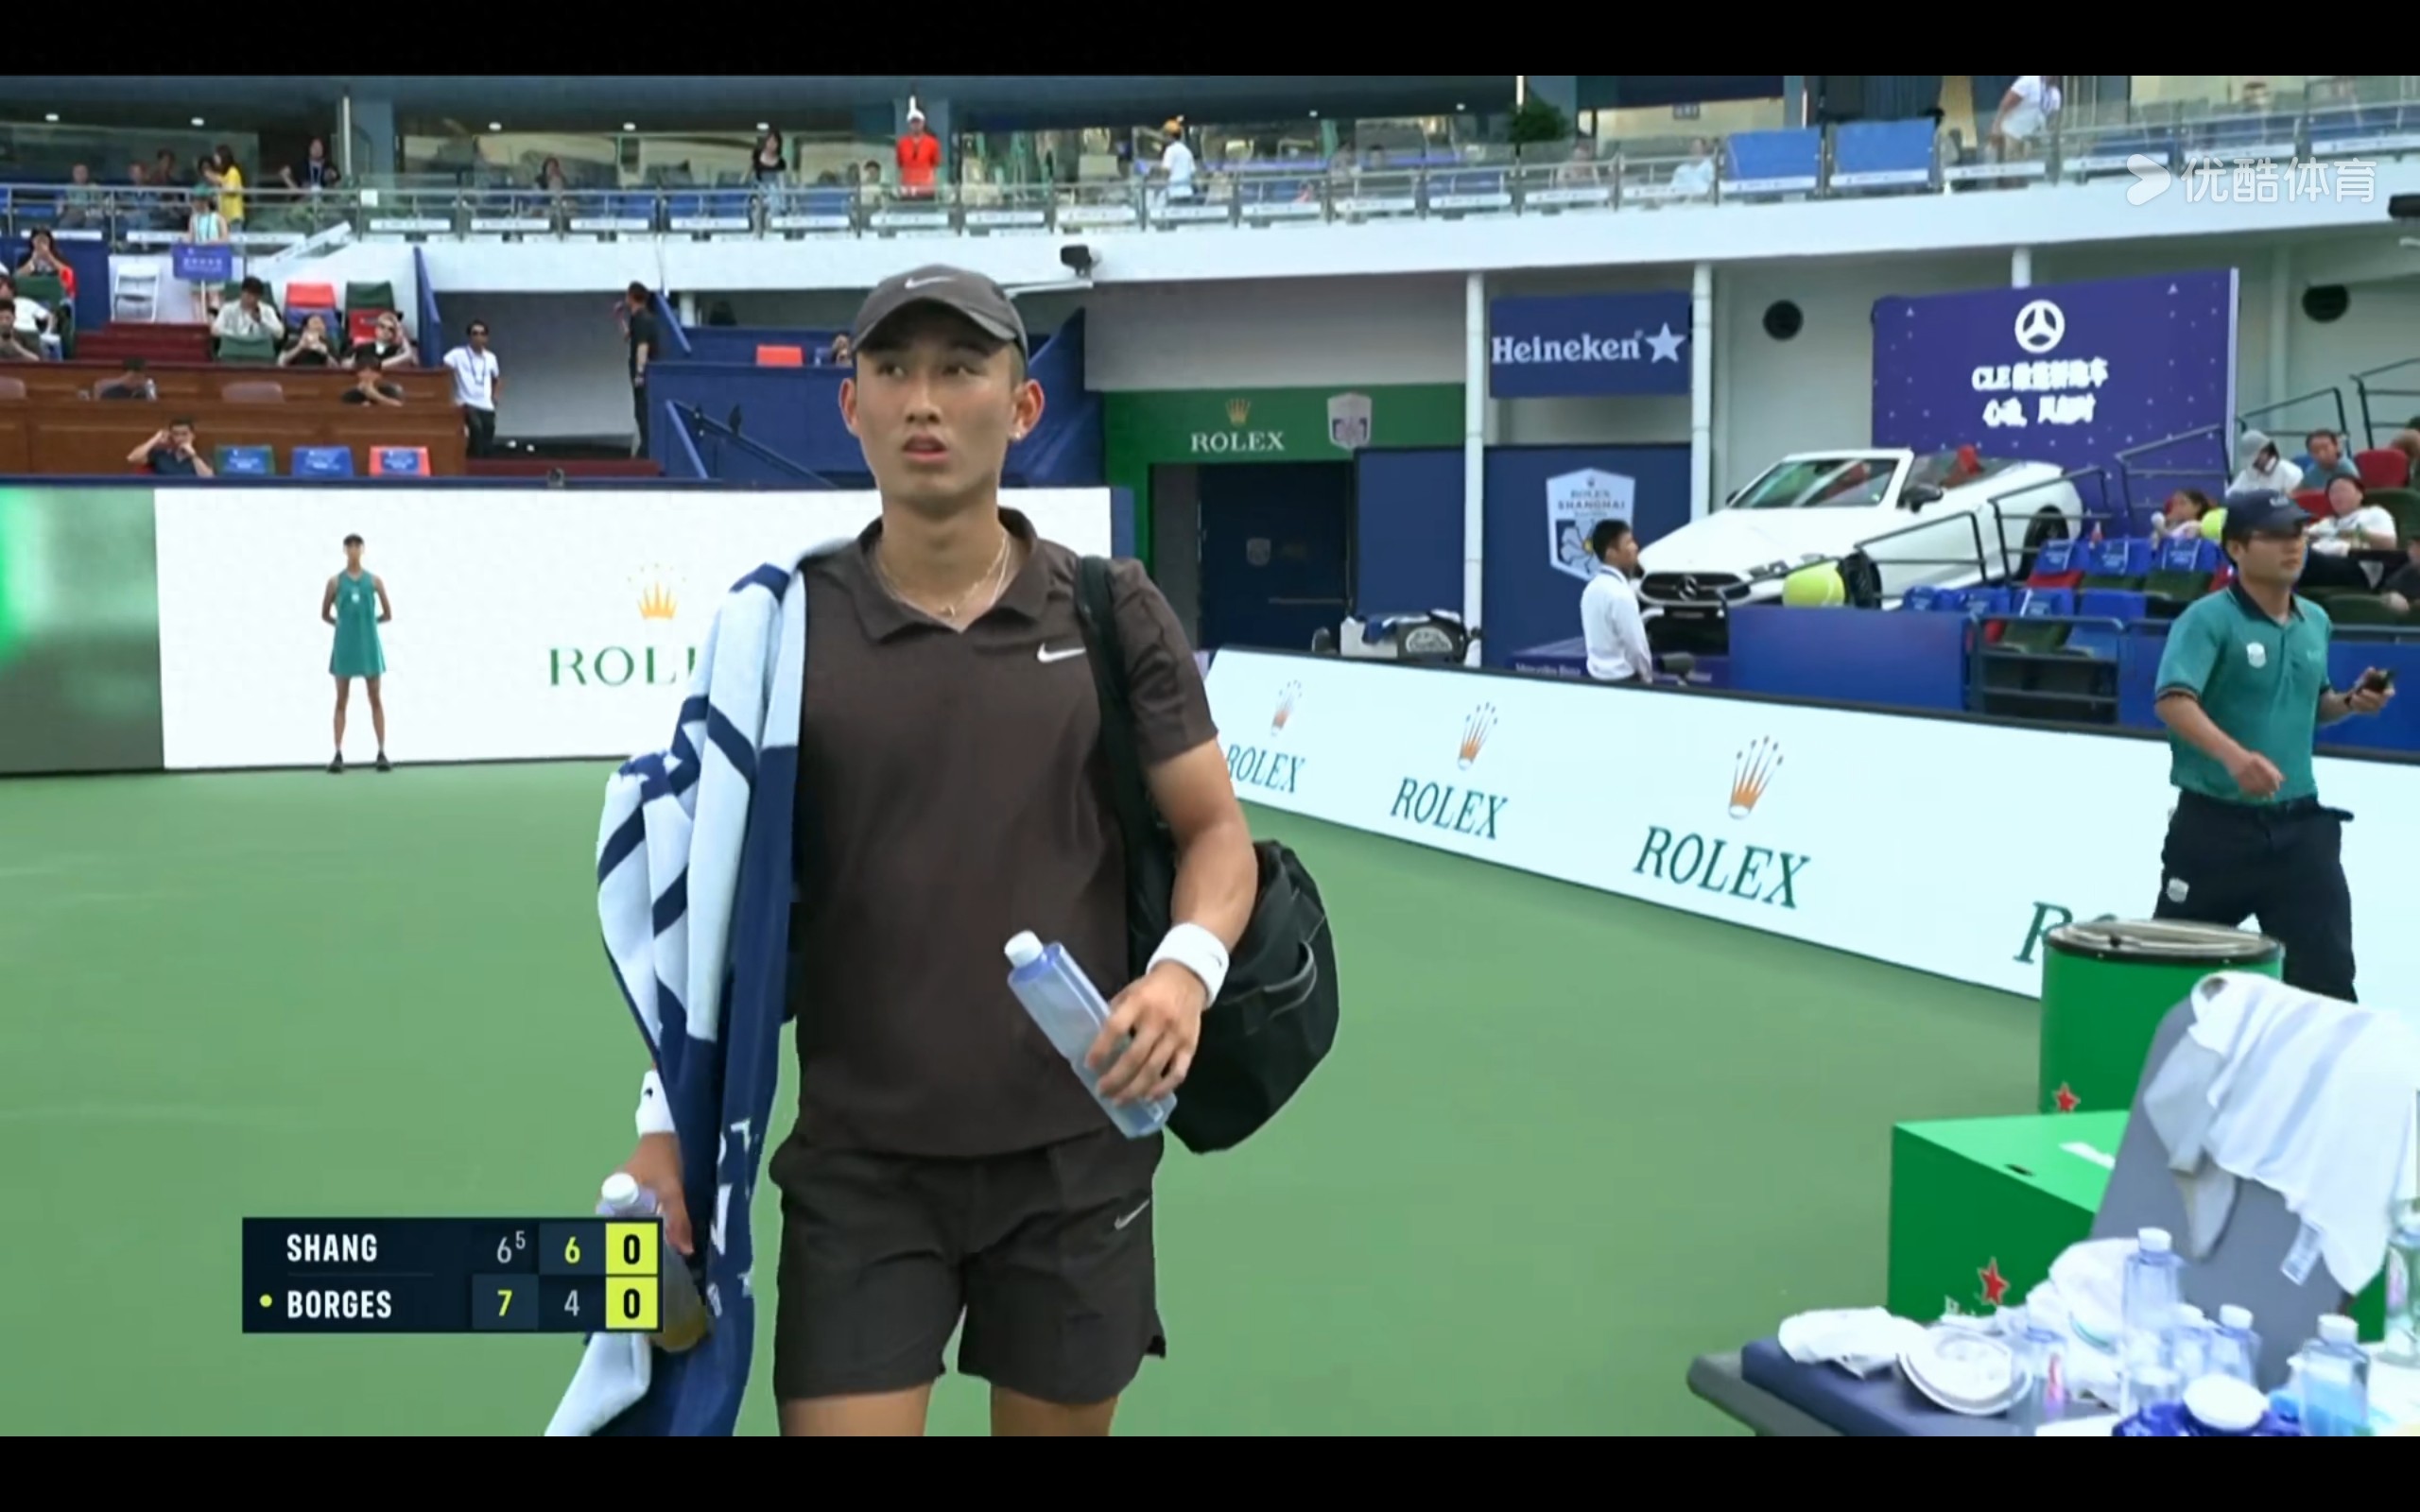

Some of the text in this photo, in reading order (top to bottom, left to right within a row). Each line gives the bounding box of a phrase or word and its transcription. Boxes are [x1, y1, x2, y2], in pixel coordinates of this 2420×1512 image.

[1492, 333, 1641, 364] Heineken
[1191, 430, 1286, 453] ROLEX
[1557, 500, 1626, 510] SHANGHAI
[550, 646, 696, 687] ROL
[1390, 777, 1509, 840] ROLEX
[1632, 825, 1811, 910] ROLEX
